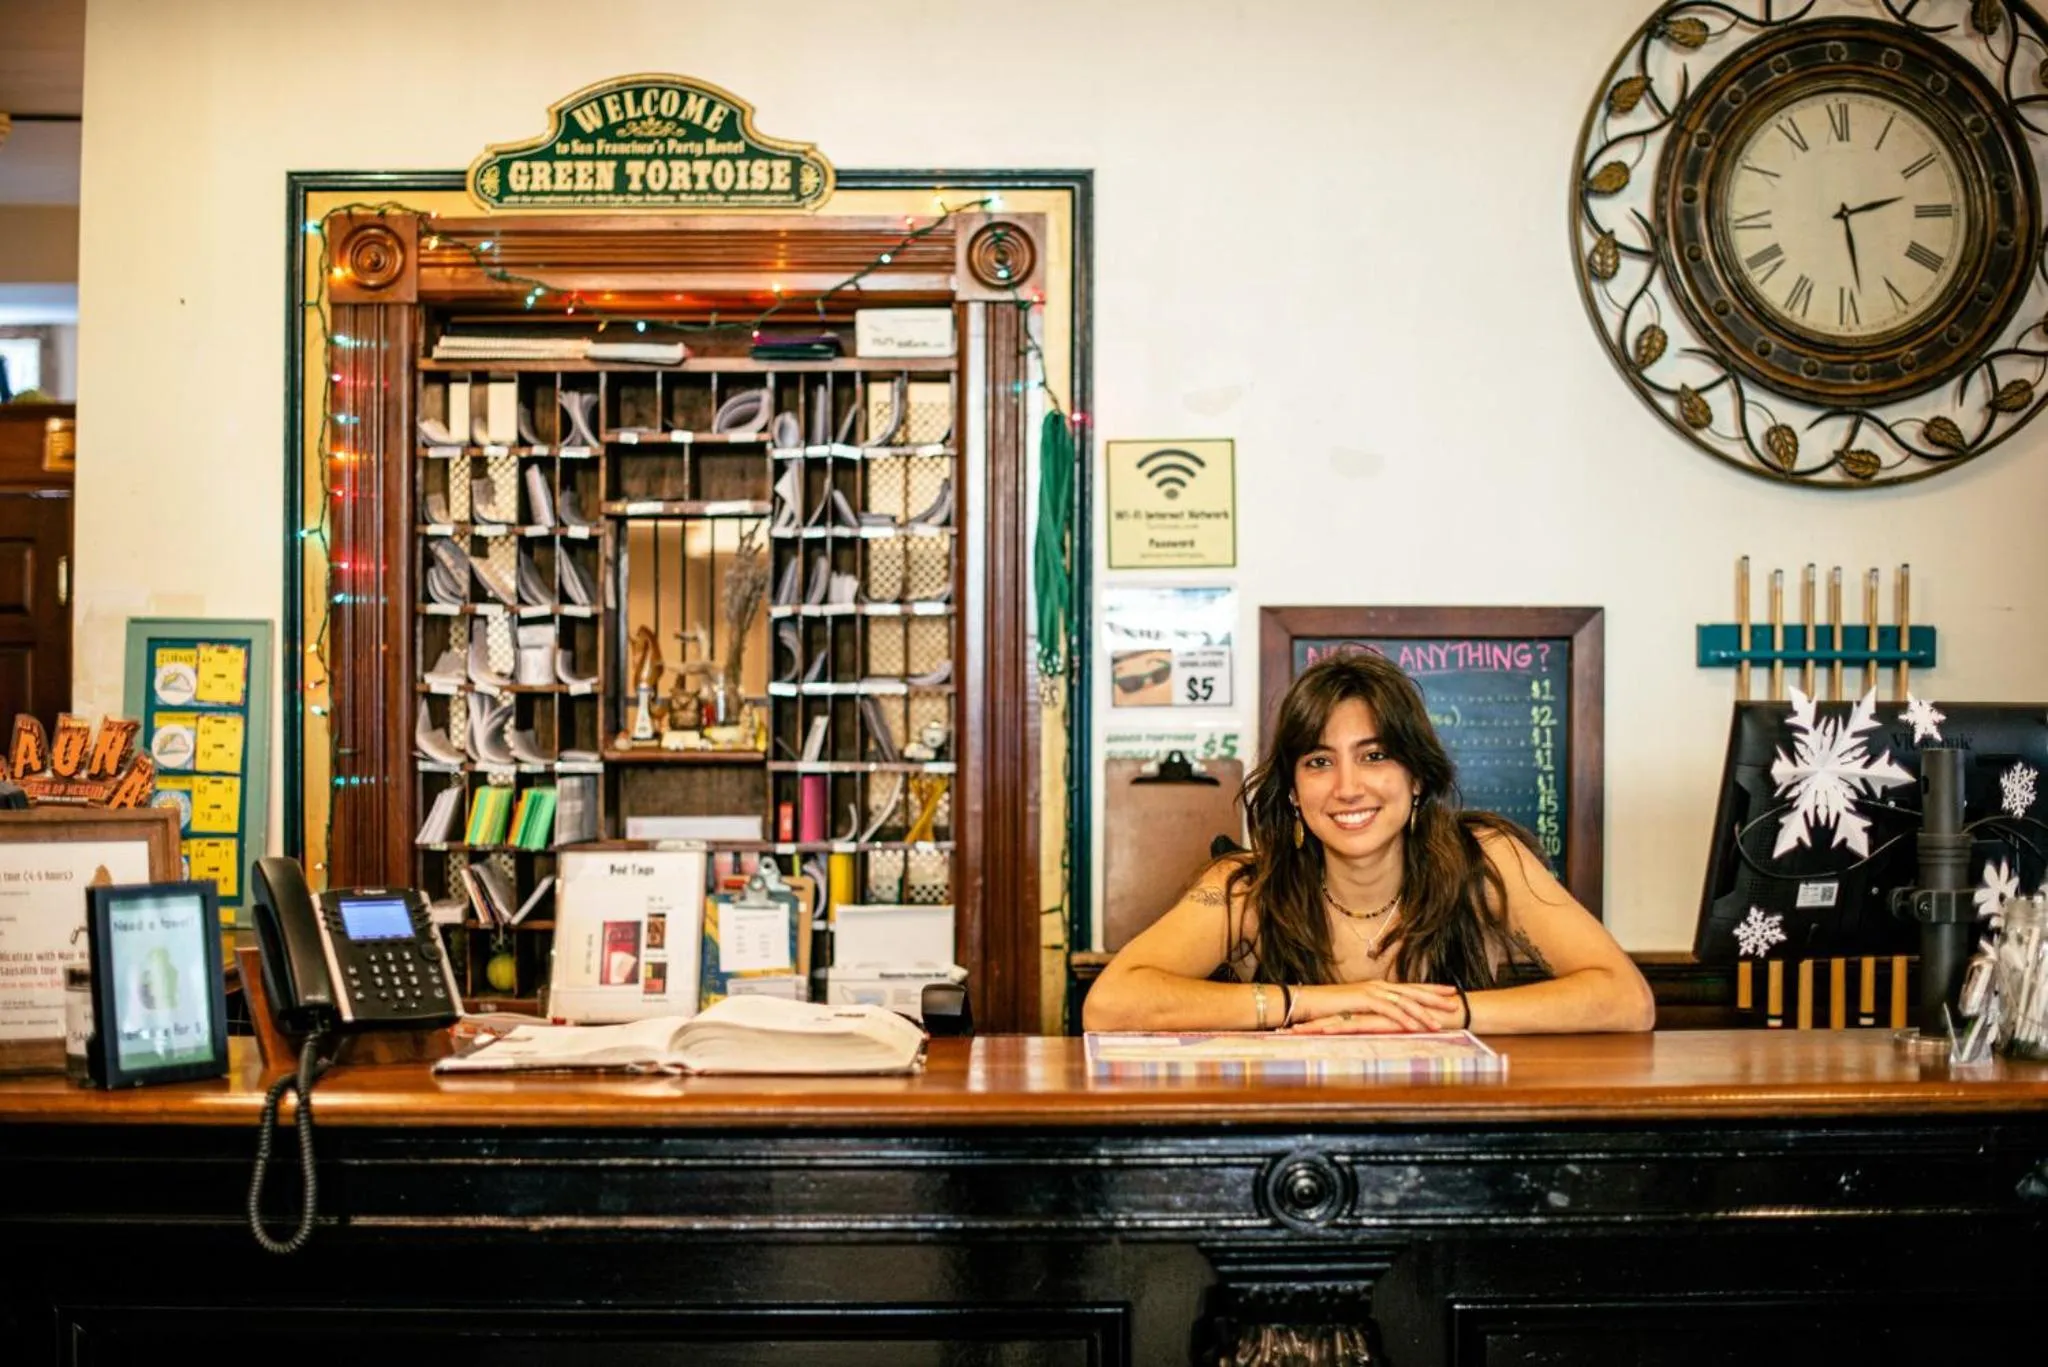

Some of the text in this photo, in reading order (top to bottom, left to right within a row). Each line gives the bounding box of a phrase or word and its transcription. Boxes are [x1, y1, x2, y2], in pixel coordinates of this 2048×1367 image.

[572, 87, 730, 135] WELCOME
[556, 141, 570, 155] to
[571, 139, 594, 155] San
[667, 139, 703, 158] Party
[507, 160, 792, 191] GREEN TORTOISE
[1187, 676, 1215, 702] $5
[1531, 679, 1556, 700] $1
[1531, 705, 1558, 727] $2
[1203, 733, 1239, 759] $5
[632, 864, 655, 876] Tags
